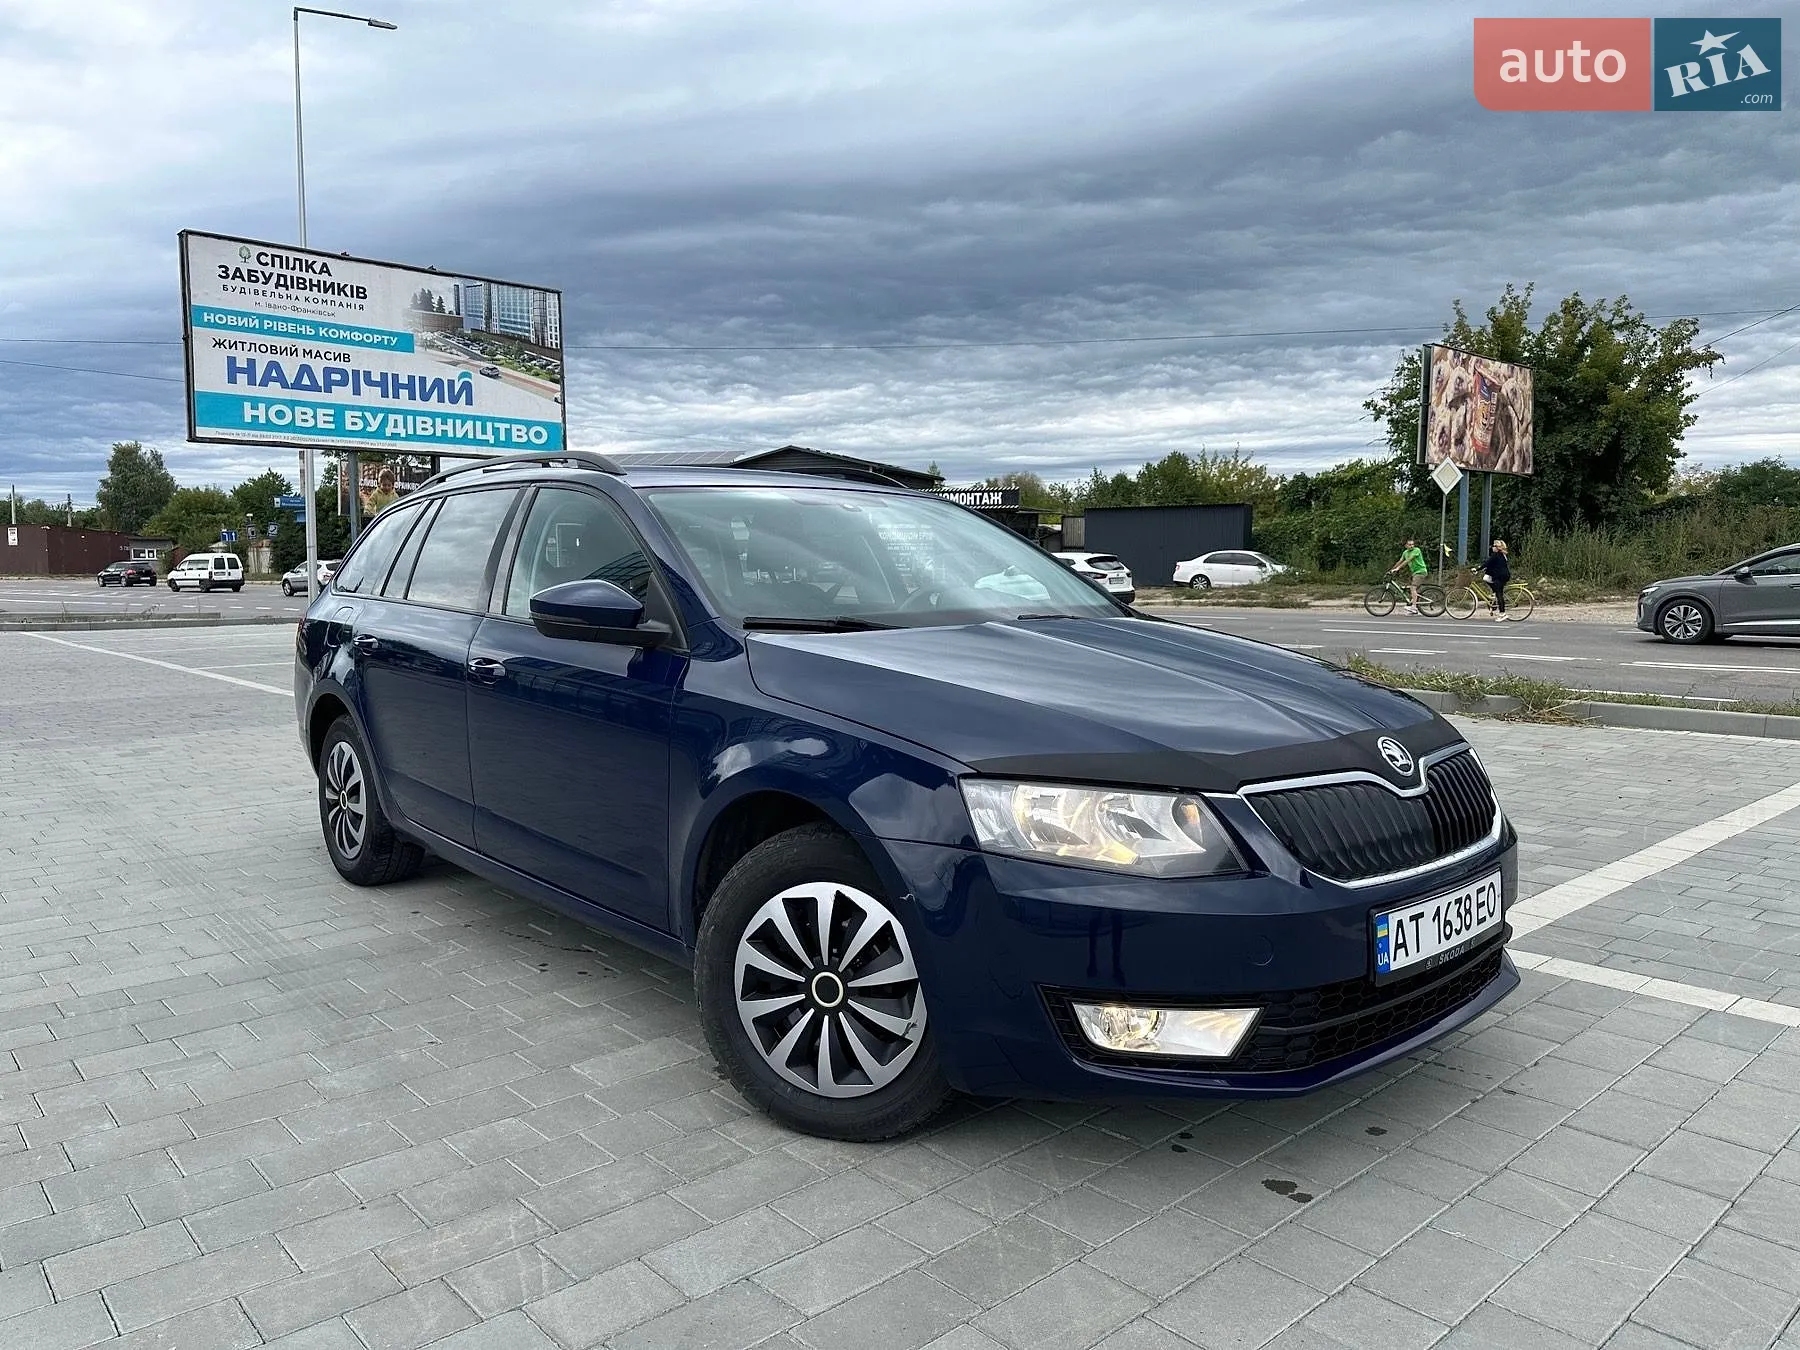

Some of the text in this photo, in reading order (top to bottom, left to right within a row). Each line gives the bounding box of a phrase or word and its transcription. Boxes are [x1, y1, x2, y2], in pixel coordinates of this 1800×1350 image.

[217, 264, 368, 300] ЗАБУДІВНИКІВ
[256, 252, 332, 277] СПІЛКА
[222, 284, 365, 311] БУДІВЕЛЬНА КОМПАНІЯ
[203, 311, 398, 346] НОВИЙ РІВЕНЬ КОМФОРТУ
[212, 337, 351, 363] ЖИТЛОВИЙ МАСИВ
[226, 355, 474, 406] НАДРІЧНИЙ
[243, 401, 336, 430] НОВЕ
[344, 409, 549, 445] БУДІВНИЦТВО
[1393, 881, 1496, 962] AT 1638 EO
[1377, 953, 1390, 966] UA
